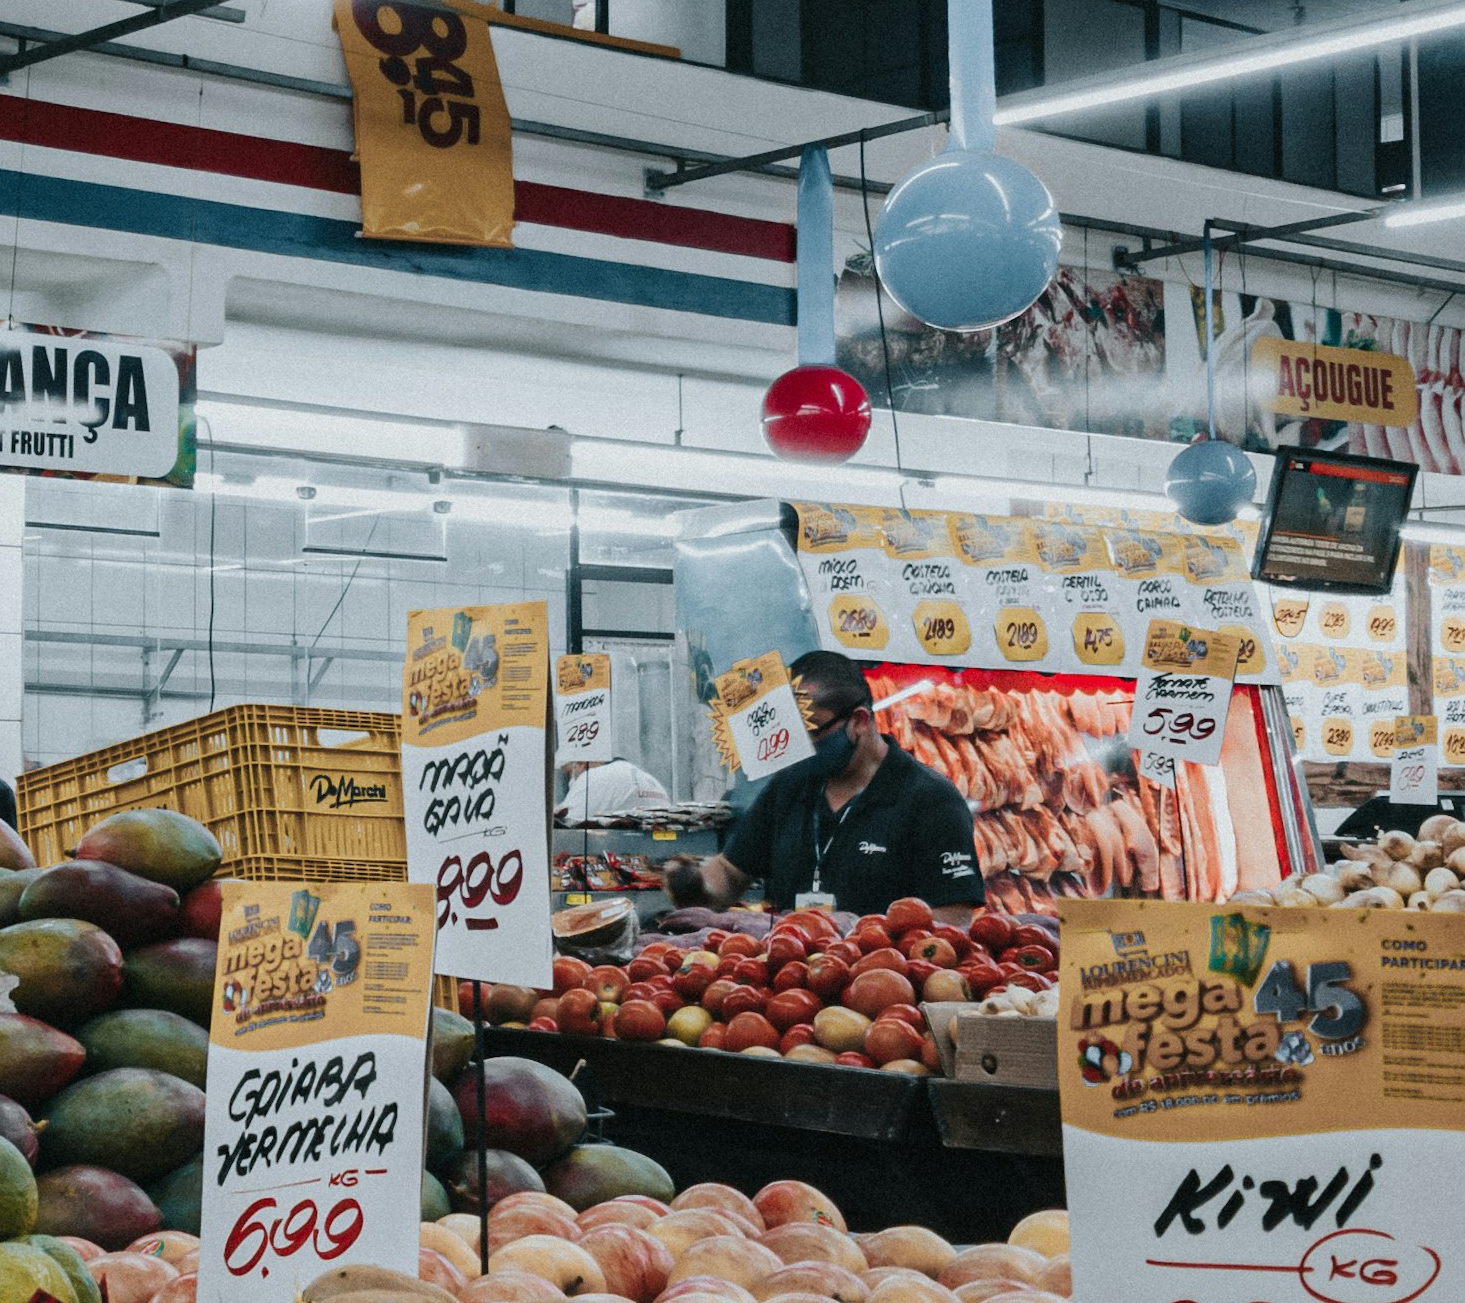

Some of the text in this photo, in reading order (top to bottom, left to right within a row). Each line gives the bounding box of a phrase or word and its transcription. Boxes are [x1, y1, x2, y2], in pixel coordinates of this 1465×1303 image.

[1278, 354, 1395, 412] AÇOUGUE
[11, 429, 74, 459] FRUTTI
[308, 774, 389, 809] DeMarchi
[223, 933, 303, 977] mega
[307, 919, 362, 975] 45
[1079, 950, 1191, 982] LOURENCINI
[1380, 939, 1427, 951] COMO
[245, 960, 318, 1002] festa
[1070, 958, 1368, 1042] mega 45
[1121, 1013, 1284, 1075] festa
[228, 1051, 377, 1130] GOIABA
[217, 1101, 399, 1187] VERMELHA
[328, 1169, 360, 1188] KG
[223, 1197, 365, 1280] 6.99
[1329, 1254, 1399, 1287] KG
